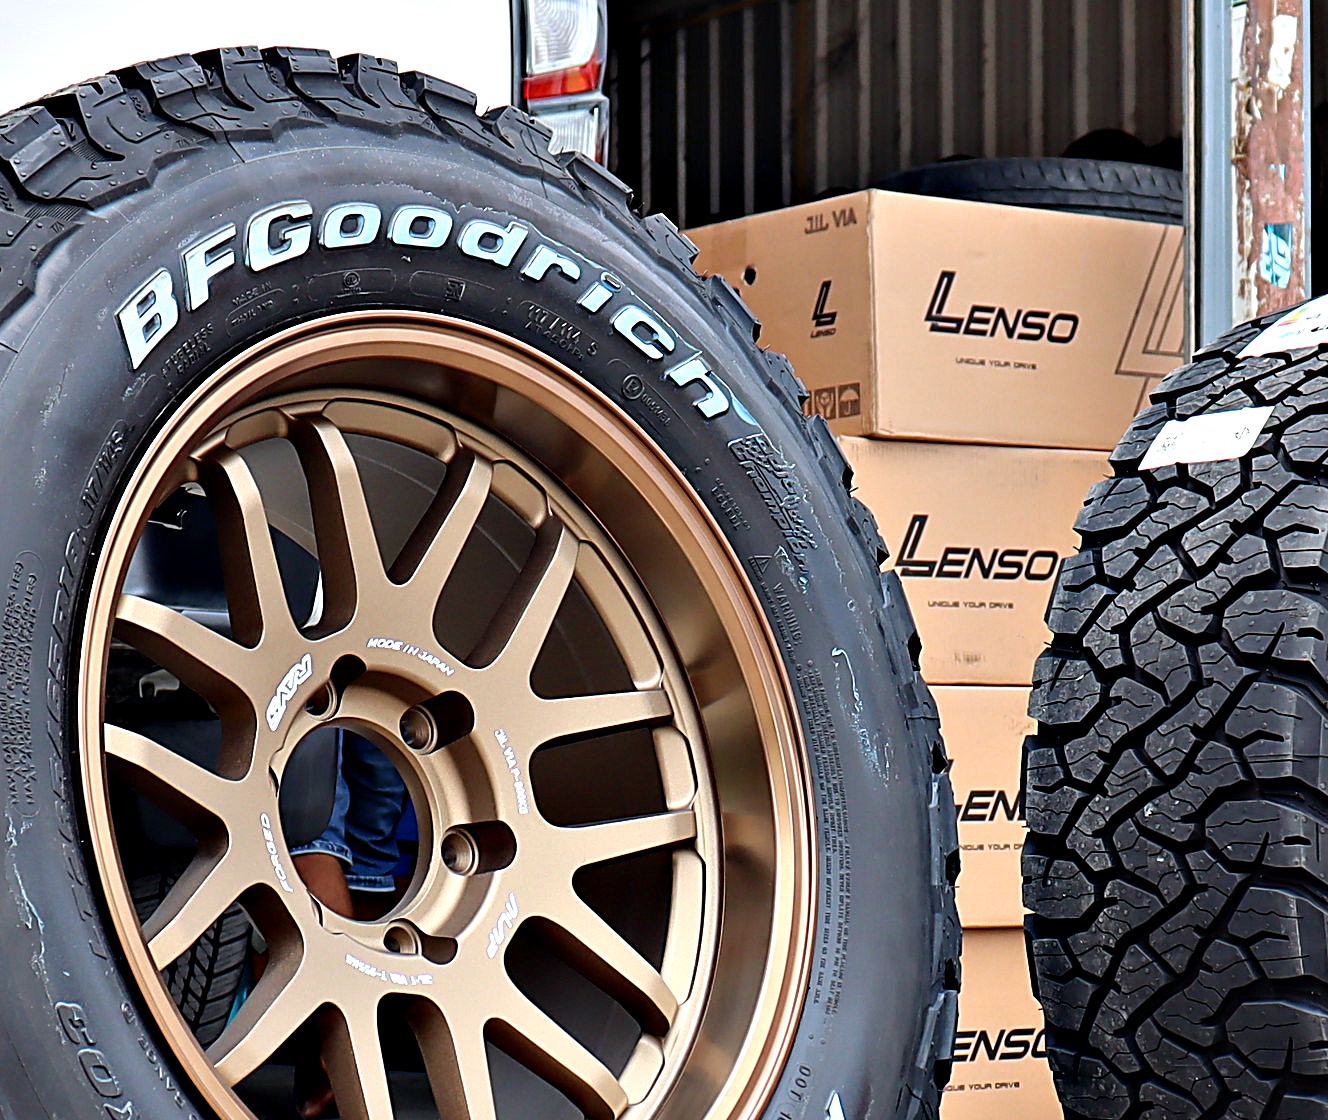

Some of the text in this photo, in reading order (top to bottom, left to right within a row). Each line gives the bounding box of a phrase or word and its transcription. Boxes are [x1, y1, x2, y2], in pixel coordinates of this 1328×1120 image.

[832, 206, 858, 228] VIA
[115, 200, 736, 420] BFGoodrich
[924, 270, 1080, 344] LENSO
[987, 358, 1012, 369] YOUR
[894, 514, 1060, 581] LENSO
[927, 600, 1014, 610] UNIQUE YOUR DRIVE
[418, 647, 455, 677] JAPAN
[995, 1081, 1020, 1089] DRIVE
